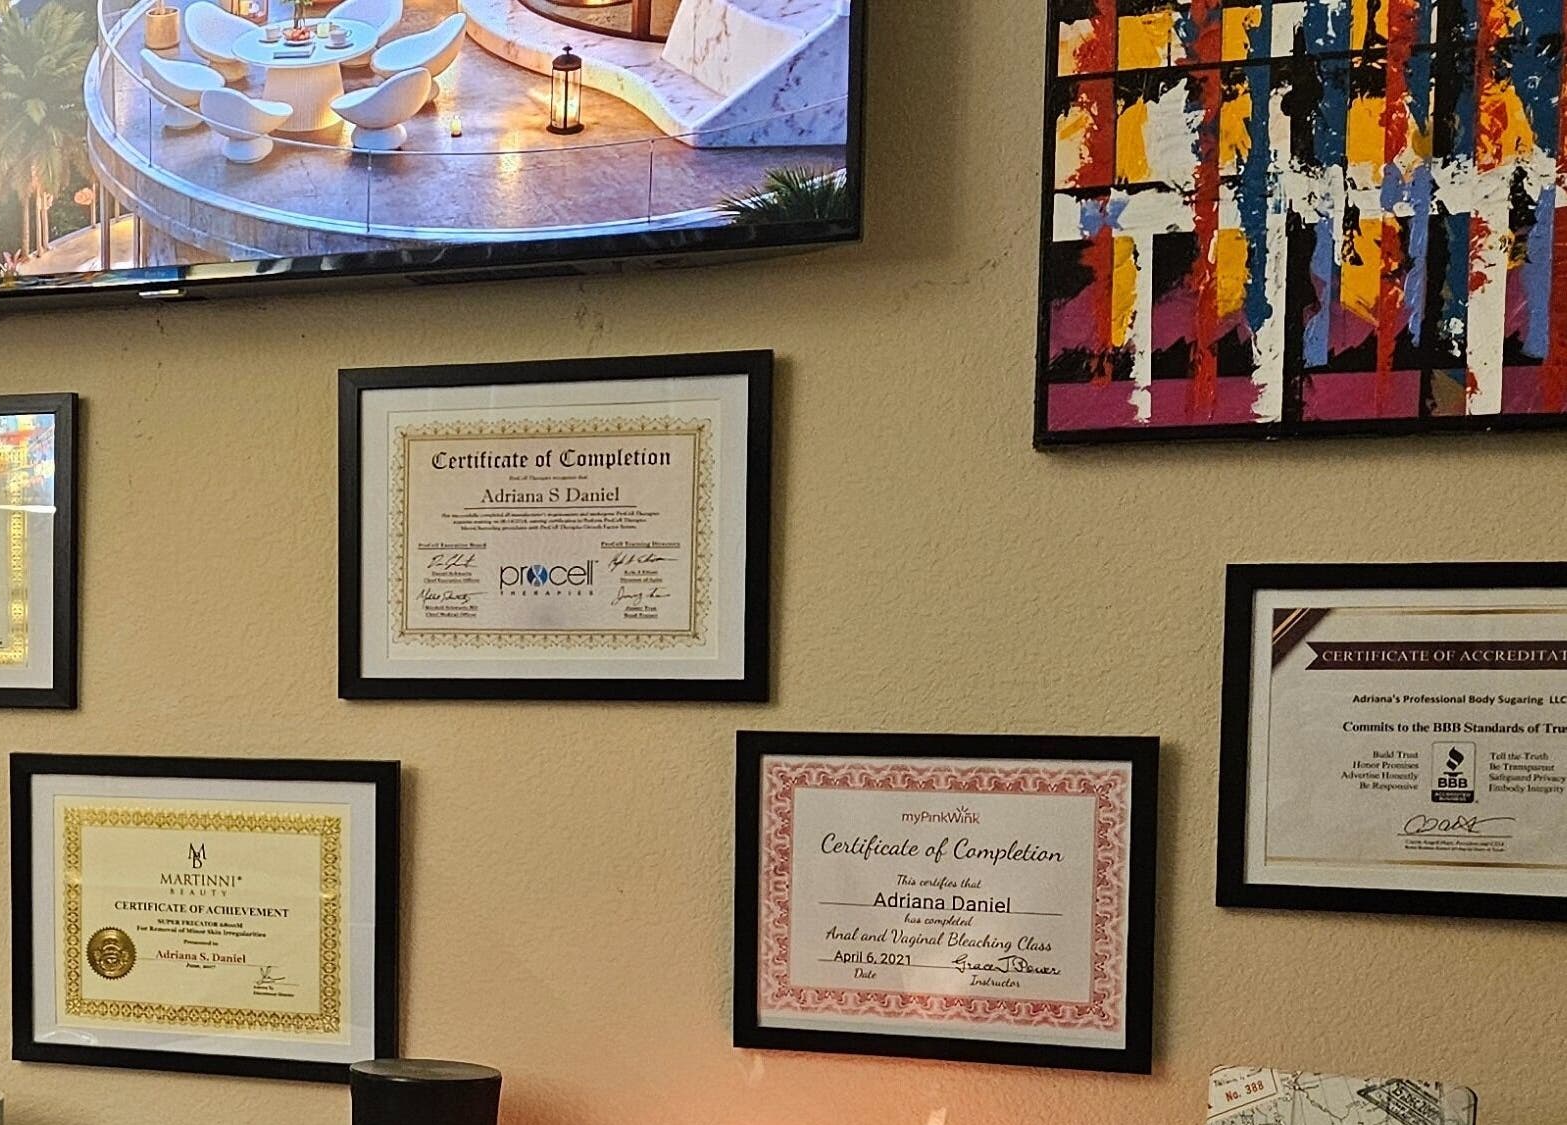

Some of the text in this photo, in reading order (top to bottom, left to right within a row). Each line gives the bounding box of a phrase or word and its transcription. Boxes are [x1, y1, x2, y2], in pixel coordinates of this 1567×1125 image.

[431, 447, 671, 470] Certificate of Completion
[480, 486, 620, 504] Adriana S Daniel
[1321, 650, 1430, 662] CERTIFICATE
[1433, 650, 1456, 662] OF
[1352, 693, 1567, 706] Adriana's Professional Body Sugaring LLC
[1342, 721, 1567, 734] Commits to the BBB Standards of Tru
[1397, 750, 1419, 759] Trust
[1490, 752, 1550, 761] Tell the Truth
[1352, 760, 1419, 769] Honor Promises
[1489, 762, 1555, 774] Be Transparent
[1340, 771, 1419, 782] Advertise Honestly
[1437, 777, 1468, 789] BBB
[1488, 773, 1567, 784] Safeguard Privacy
[1359, 781, 1419, 792] Be Responsive
[1488, 784, 1565, 794] Embody Integrity
[901, 808, 981, 825] myPinkWink
[820, 832, 1065, 866] Certificate of Completion
[896, 874, 982, 890] This certifies that
[169, 888, 228, 897] BEAUTY
[872, 892, 1011, 914] Adriana Daniel
[114, 901, 290, 919] CERTIFICATE OF ACHIEVEMENT
[903, 913, 975, 928] has completed
[825, 926, 1053, 954] Anal and Vaginal Bleaching Class
[155, 949, 247, 964] Adriana S. Daniel
[833, 950, 912, 966] April 6, 2021
[853, 968, 878, 980] Date
[969, 974, 1022, 989] Instructor
[1225, 1080, 1265, 1102] No. 388
